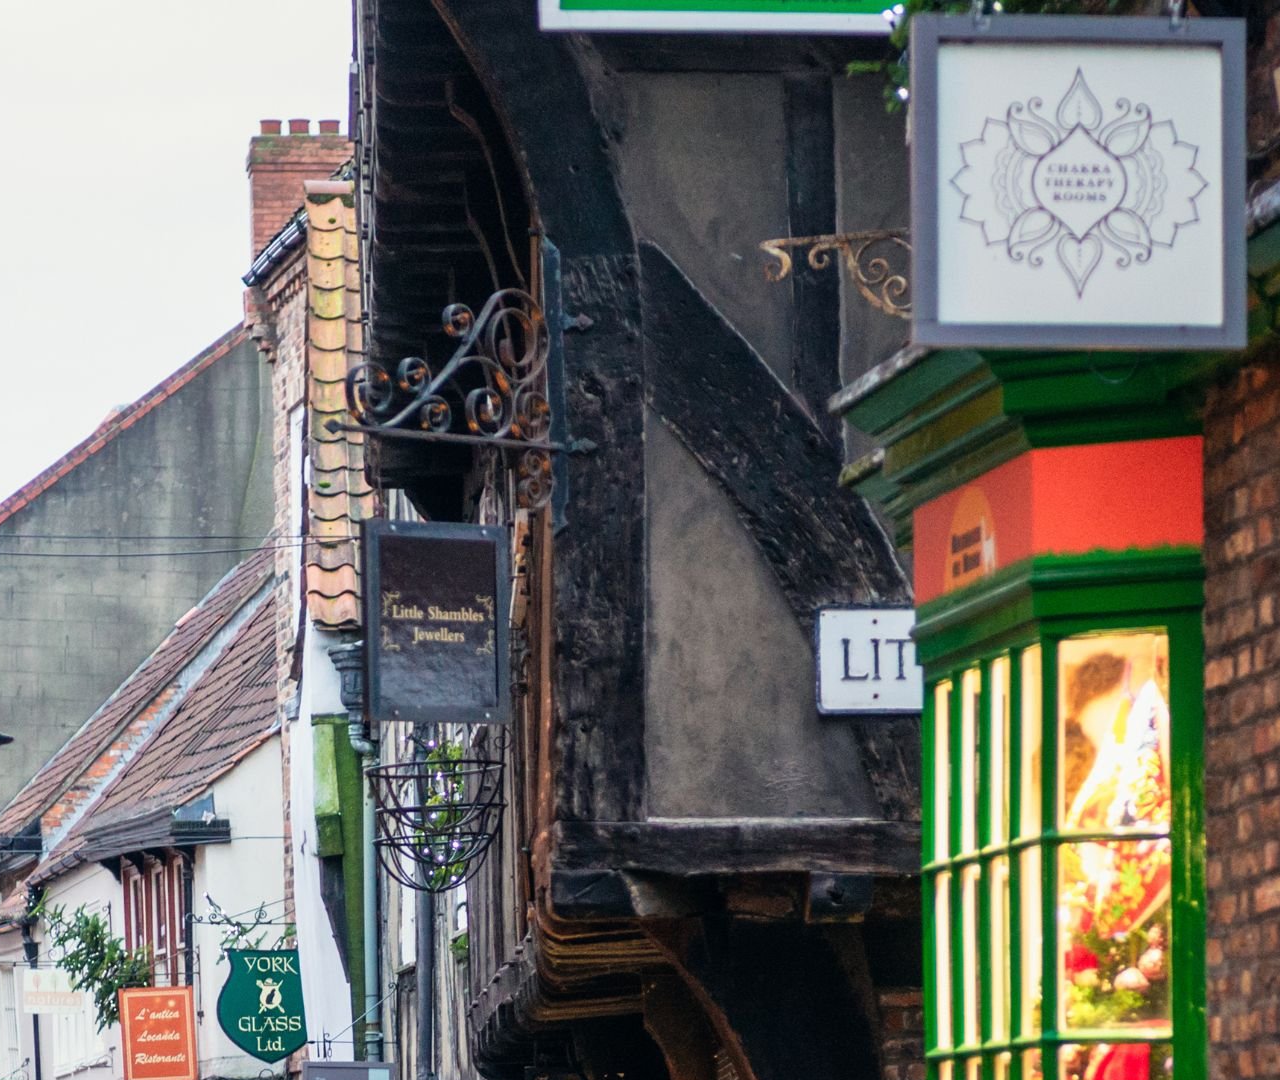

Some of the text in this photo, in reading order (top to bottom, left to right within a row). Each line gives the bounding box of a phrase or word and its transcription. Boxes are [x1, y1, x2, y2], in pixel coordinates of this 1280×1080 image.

[1047, 164, 1111, 173] CHAKRA
[1045, 177, 1114, 187] THERAPY
[1053, 191, 1107, 201] ROOMS
[392, 605, 485, 622] Little Shambles
[412, 626, 465, 644] Jewellers
[841, 638, 913, 681] LIT
[243, 956, 298, 974] YORK
[238, 1016, 302, 1032] GLASS
[137, 1030, 181, 1043] Locanda
[256, 1036, 286, 1051] Ltd.
[134, 1052, 186, 1065] Ristorante
